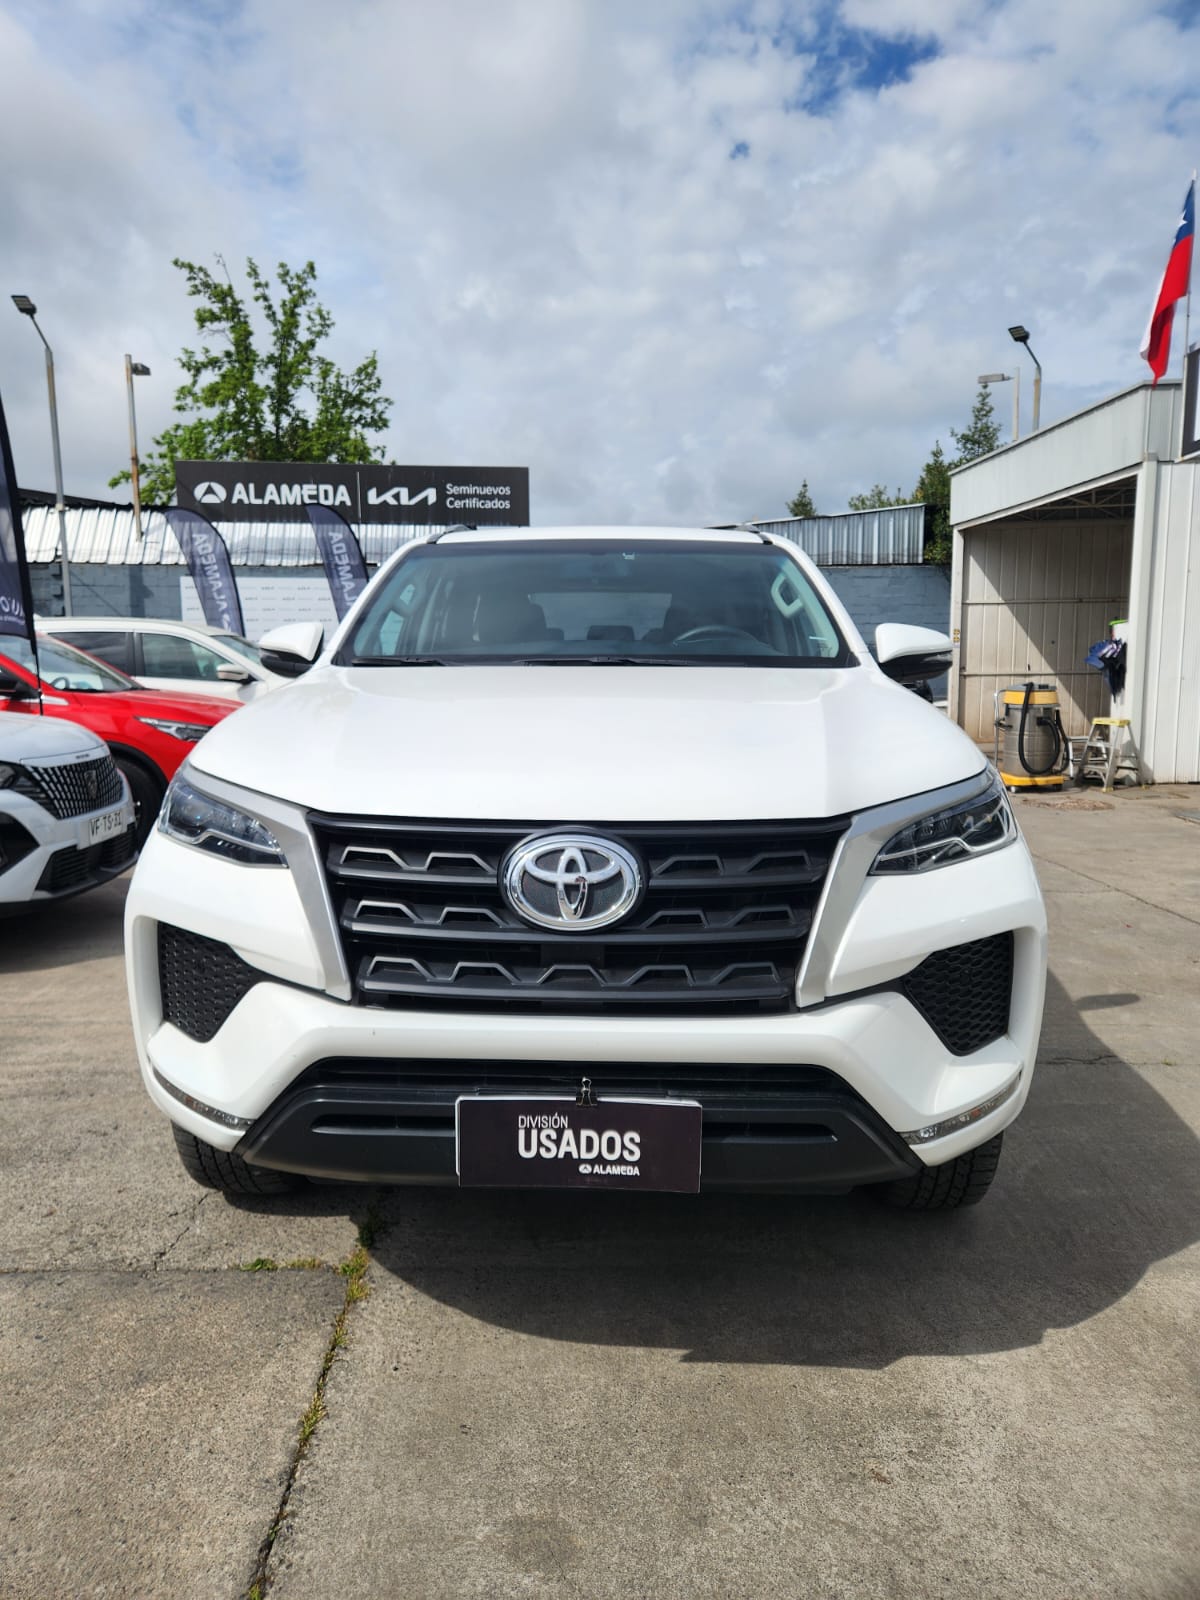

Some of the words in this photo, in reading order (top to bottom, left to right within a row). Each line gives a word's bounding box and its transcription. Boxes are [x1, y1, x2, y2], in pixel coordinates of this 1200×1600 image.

[231, 482, 352, 506] ALAMEDA
[445, 483, 511, 496] Seminuevos
[445, 497, 511, 509] Certificados
[518, 1112, 568, 1129] DIVISIÓN
[518, 1129, 641, 1162] USADOS
[593, 1164, 640, 1176] ALAMEDA
